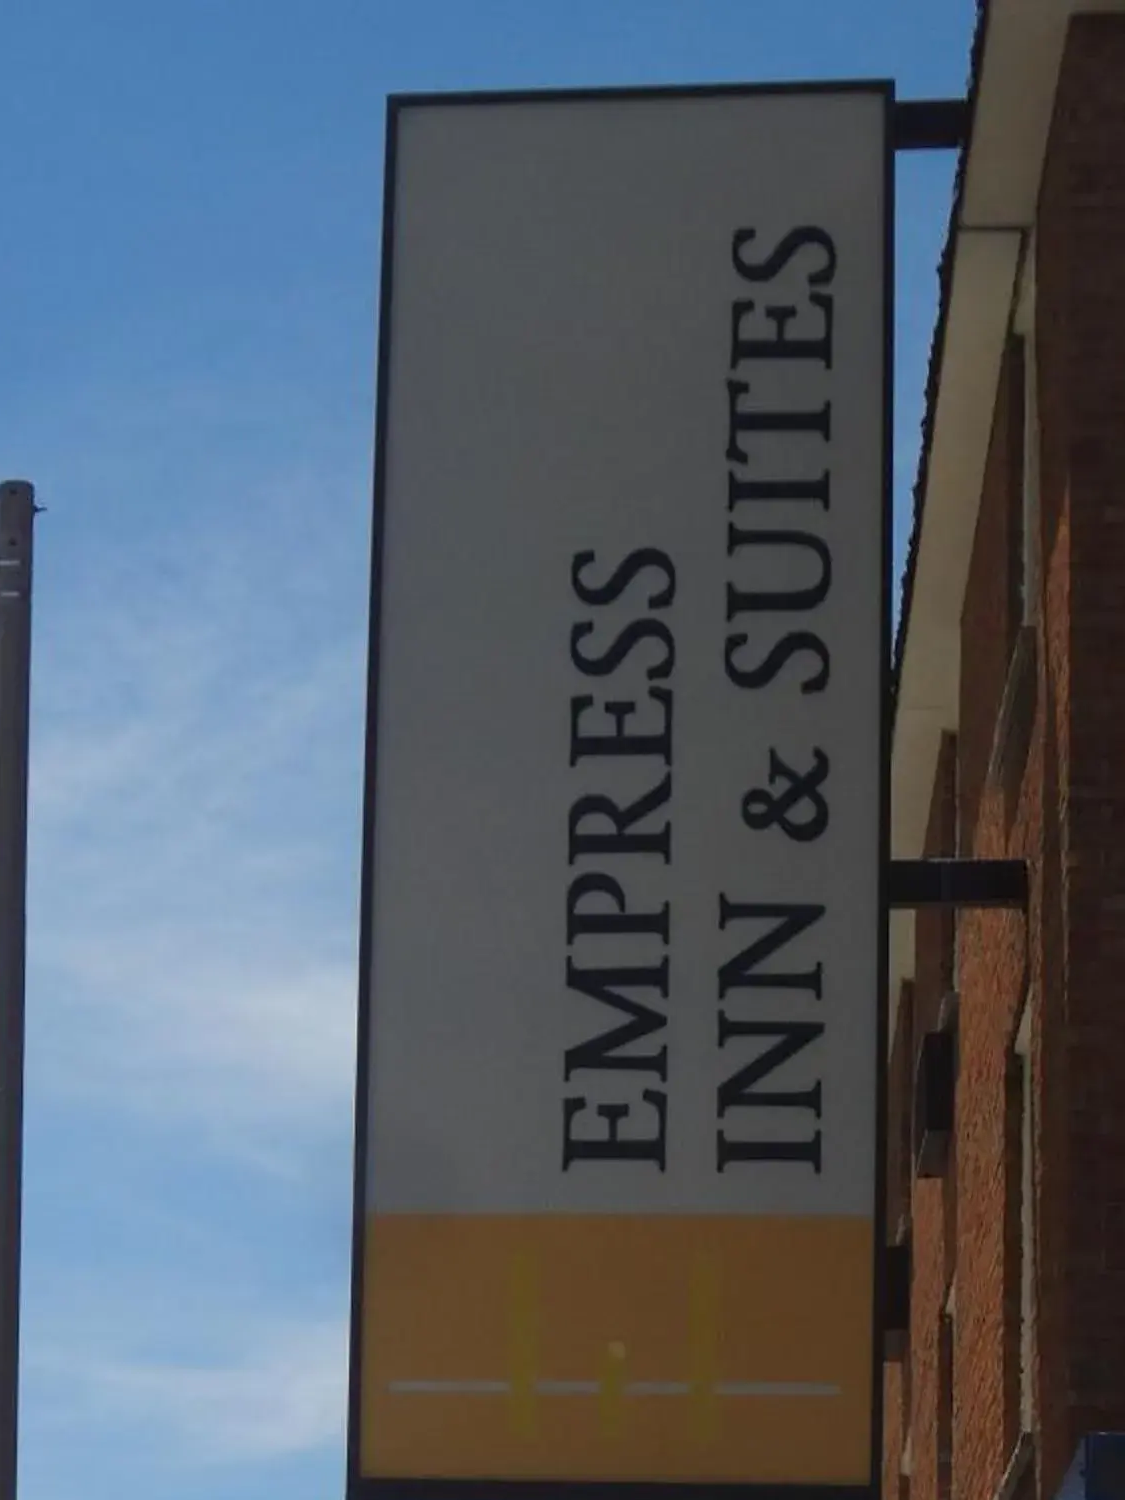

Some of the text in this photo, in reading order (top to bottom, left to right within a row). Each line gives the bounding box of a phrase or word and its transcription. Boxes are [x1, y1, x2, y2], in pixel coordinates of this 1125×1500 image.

[562, 547, 676, 1173] EMPRESS
[717, 225, 837, 1174] INN & SUITES
